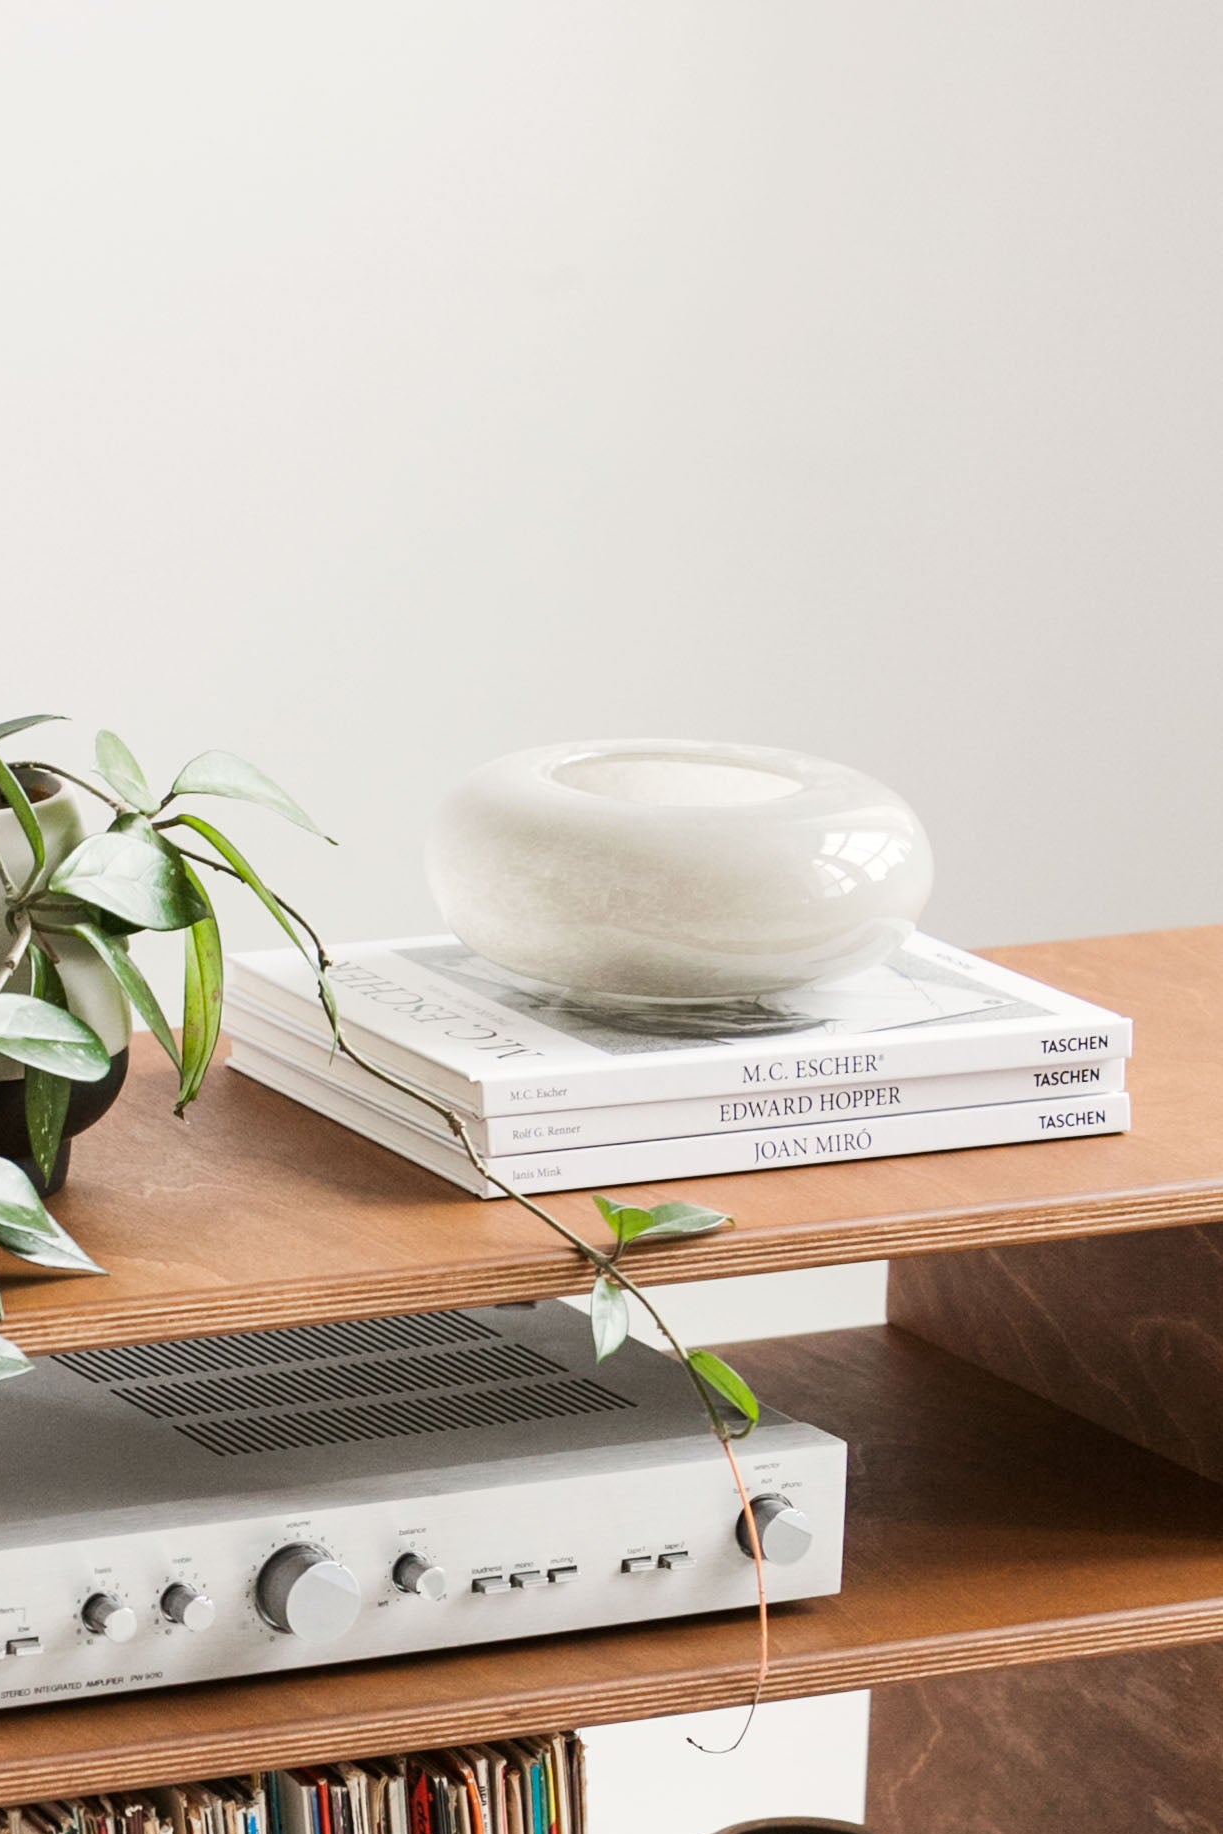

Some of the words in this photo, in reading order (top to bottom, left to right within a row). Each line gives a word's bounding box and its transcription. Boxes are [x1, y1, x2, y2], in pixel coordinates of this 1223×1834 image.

[1041, 1035, 1108, 1054] TASCHEN
[742, 1062, 789, 1084] M.C.
[1034, 1068, 1100, 1087] TASCHEN
[536, 1086, 568, 1099] Escher
[720, 1095, 813, 1122] EDWARD
[819, 1086, 902, 1112] HOPPER
[1038, 1110, 1106, 1129] TASCHEN
[512, 1126, 532, 1140] Rolf
[533, 1127, 545, 1138] G.
[547, 1124, 581, 1136] Renner
[754, 1137, 808, 1164] JOAN
[815, 1128, 872, 1155] MIRÓ
[512, 1168, 534, 1181] Janis
[536, 1165, 562, 1178] Mink
[781, 1479, 803, 1490] phono
[398, 1526, 427, 1537] balance
[471, 1565, 503, 1574] loudness
[0, 1688, 31, 1700] STEREO
[34, 1682, 83, 1696] INTEGRATED
[86, 1676, 125, 1689] AMPLIFIER
[130, 1674, 144, 1684] PW
